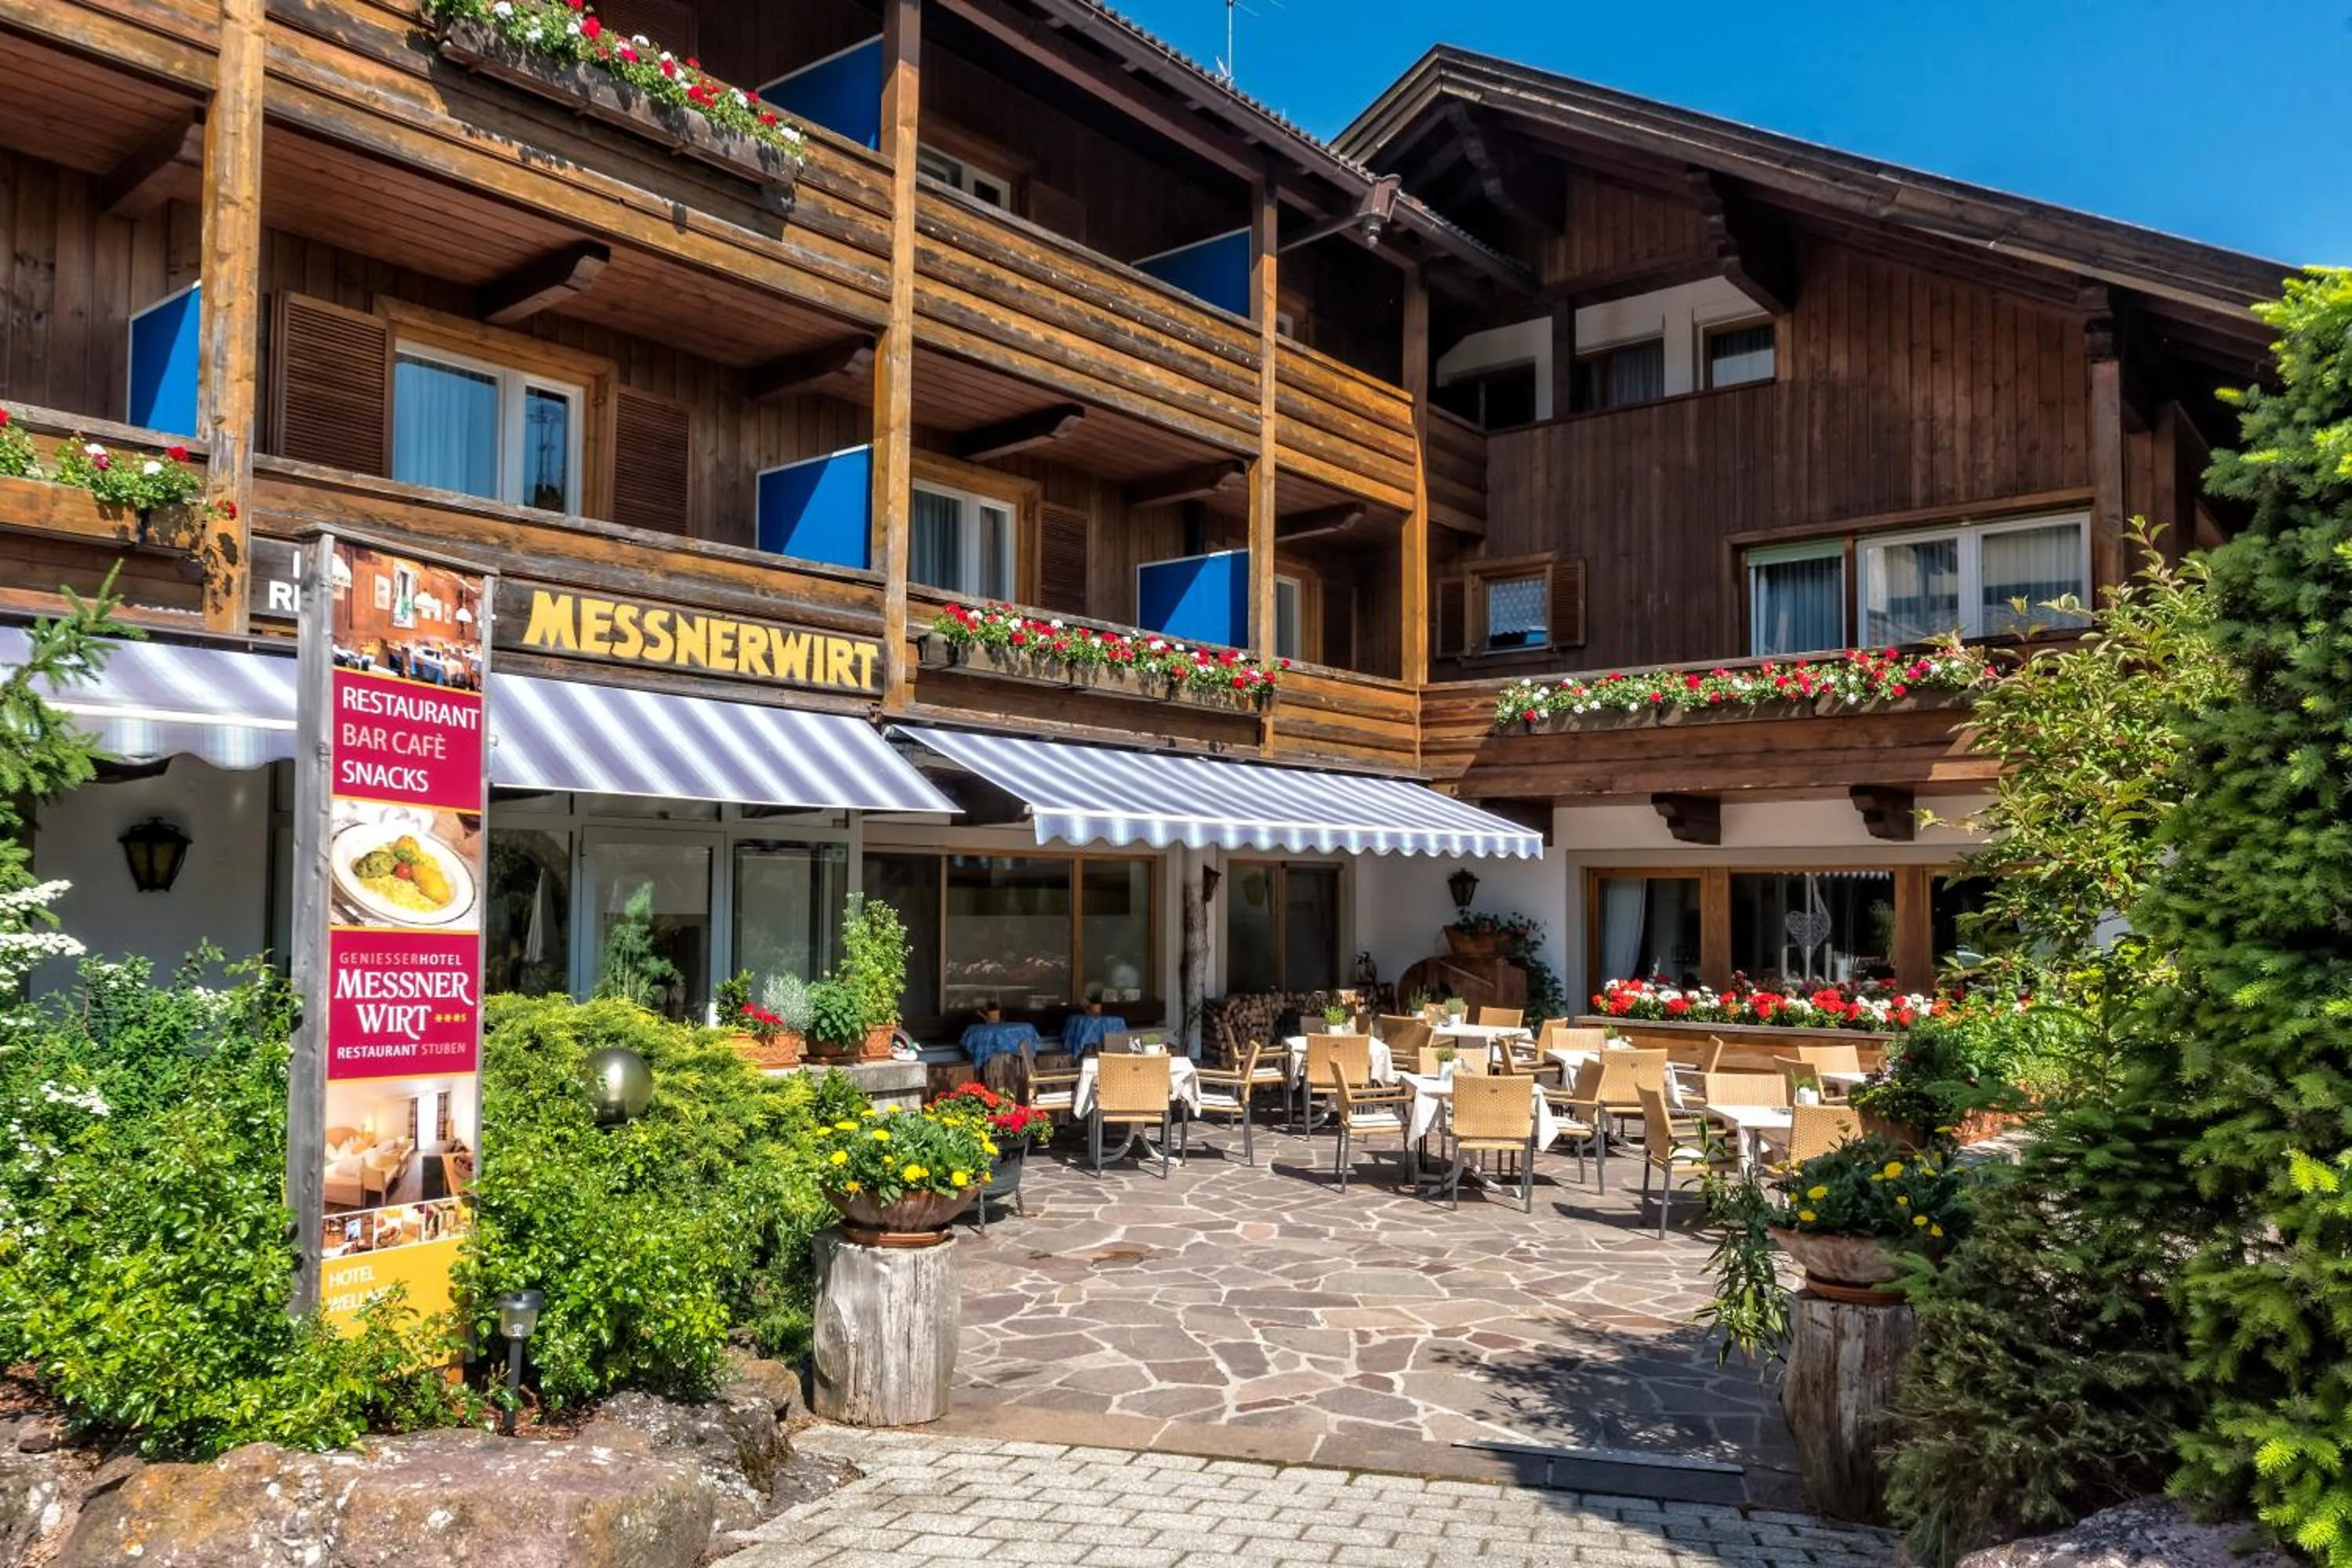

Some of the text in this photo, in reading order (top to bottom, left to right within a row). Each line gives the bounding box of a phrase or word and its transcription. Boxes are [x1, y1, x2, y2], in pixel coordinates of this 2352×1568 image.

[522, 590, 879, 690] MESSNERWIRT
[343, 686, 480, 730] RESTAURANT
[343, 723, 387, 751] BAR
[341, 760, 429, 792] SNACKS
[334, 969, 475, 1006] MESSNER
[355, 1004, 432, 1040] WIRT
[337, 1042, 466, 1059] RESTAURANT STUBEN
[329, 1266, 376, 1289] HOTEL
